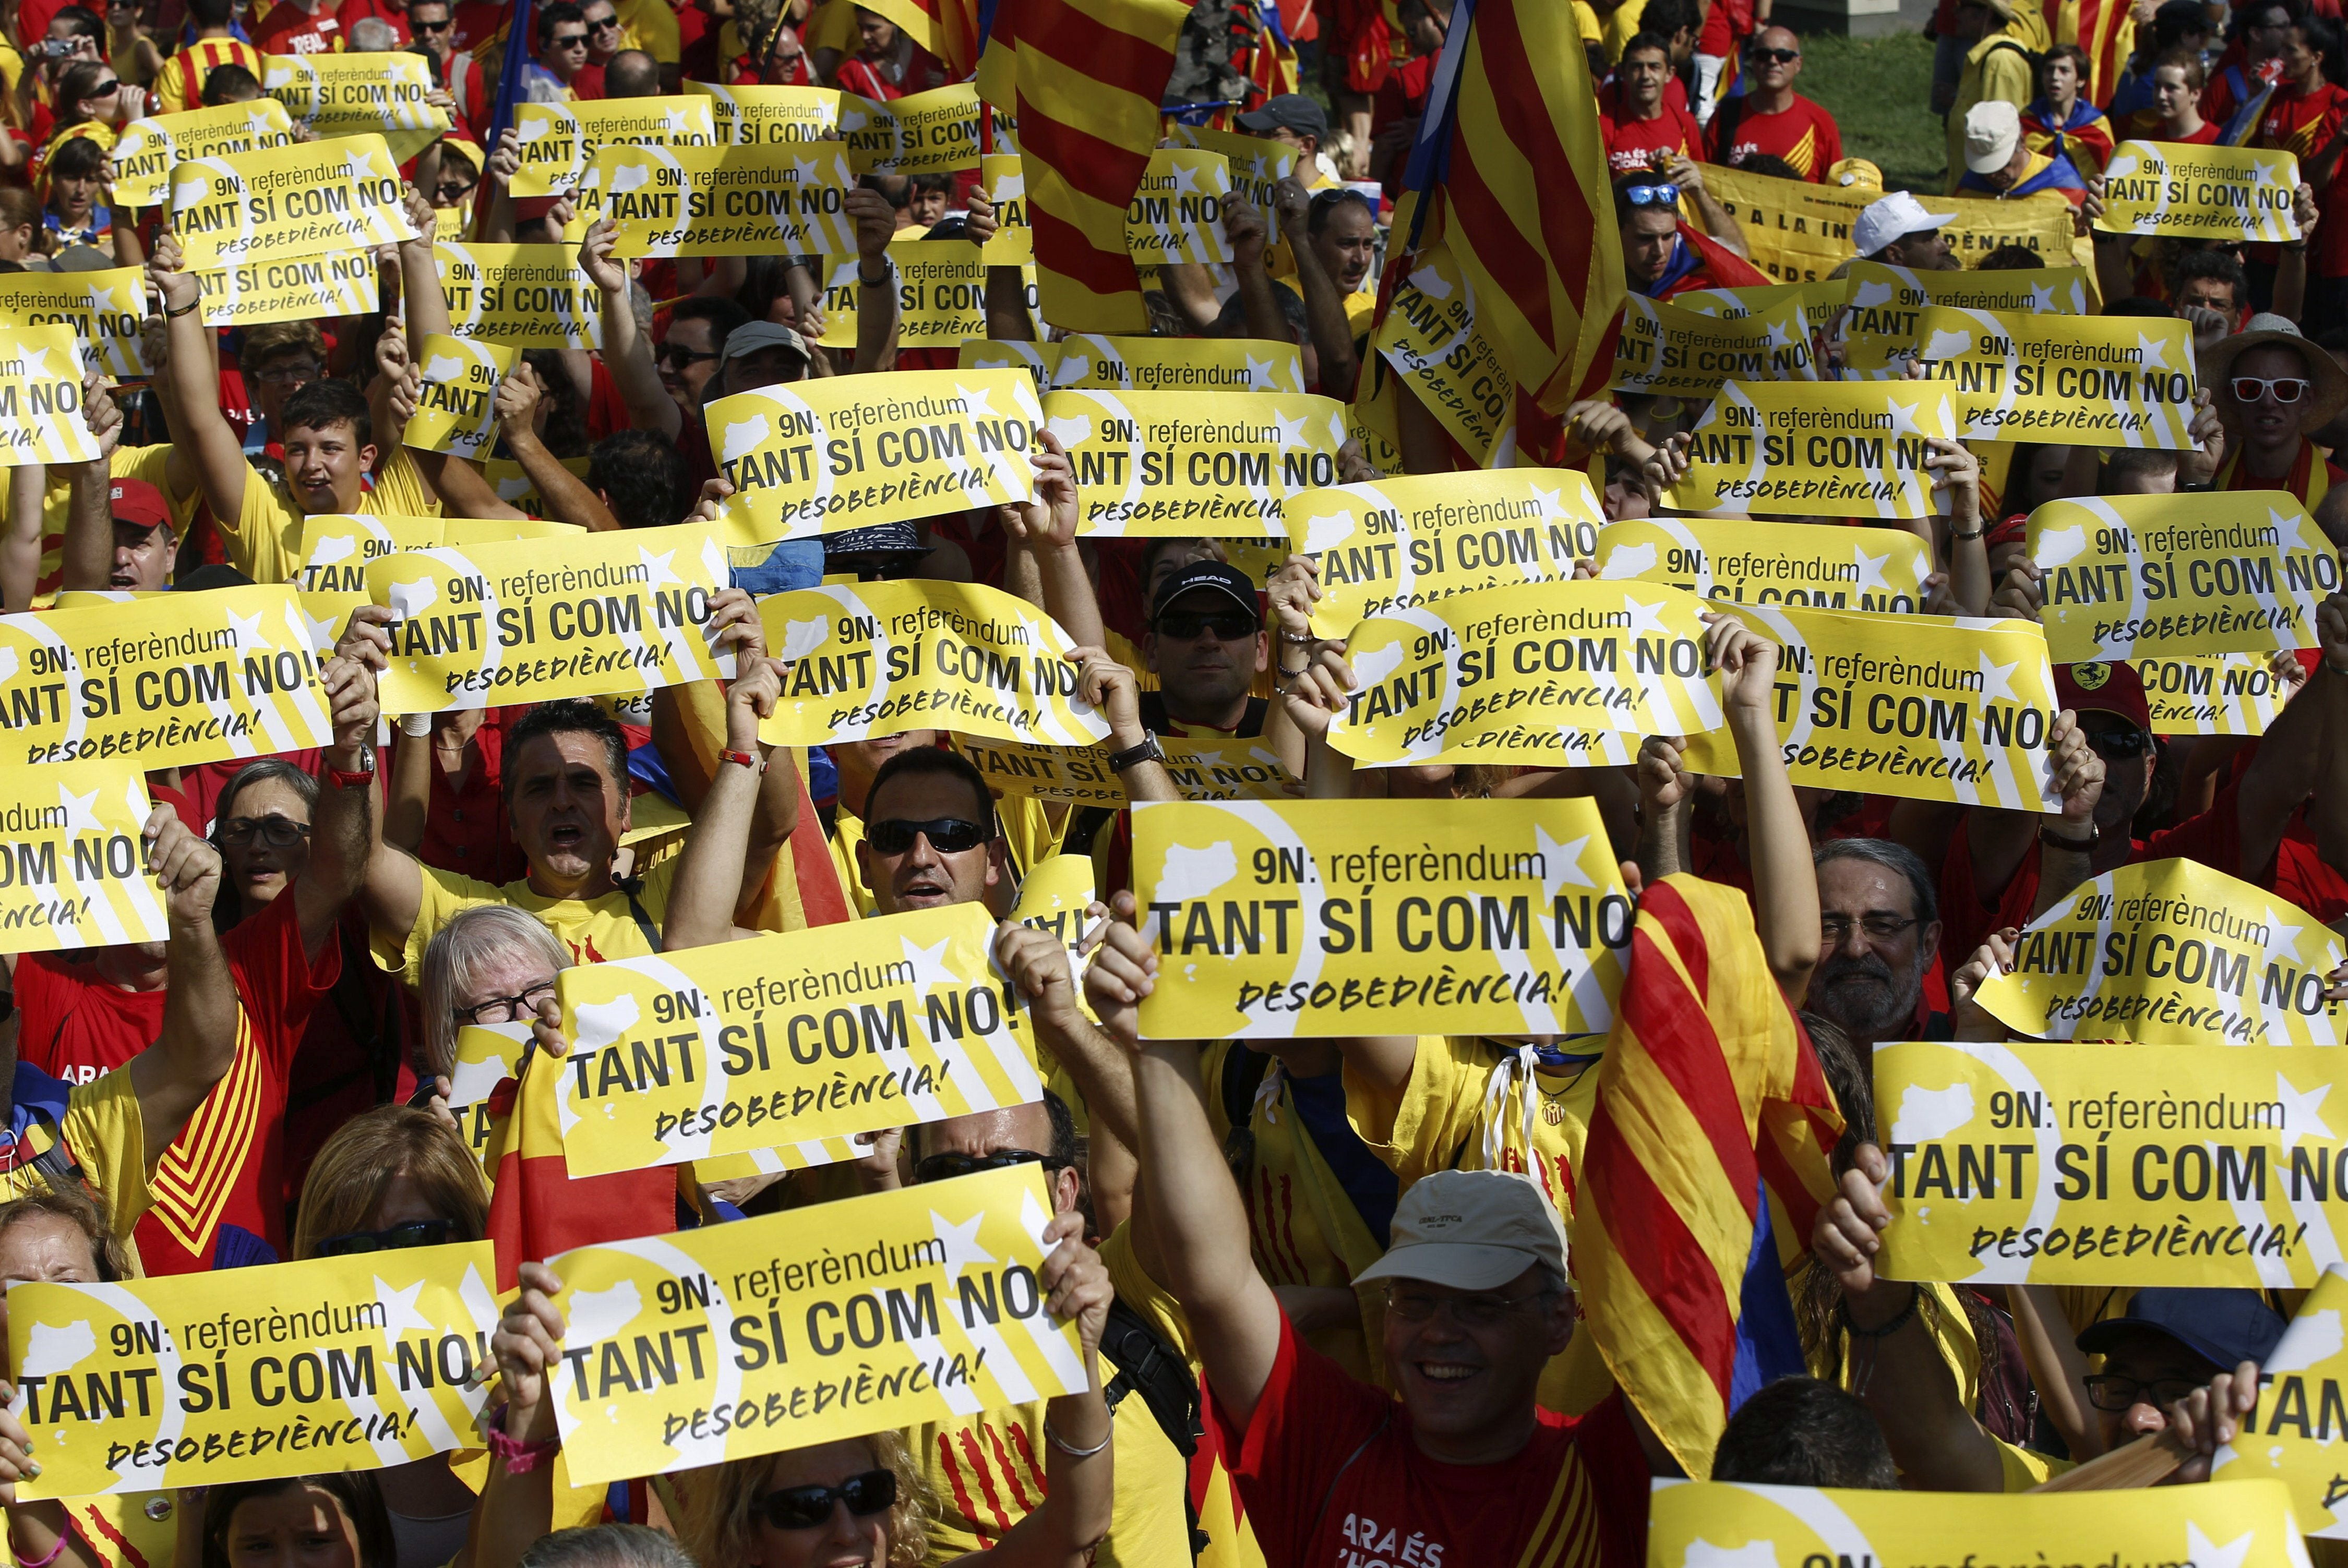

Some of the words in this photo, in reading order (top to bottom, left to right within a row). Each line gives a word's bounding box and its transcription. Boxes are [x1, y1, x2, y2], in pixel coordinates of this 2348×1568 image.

[322, 68, 392, 81] referèndum
[344, 85, 392, 103] COM
[716, 102, 739, 116] 9N:
[744, 103, 822, 118] referèndum
[148, 133, 172, 148] 9N:
[176, 121, 255, 143] referèndum
[555, 120, 580, 134] 9N:
[586, 116, 670, 133] referèndum
[872, 115, 899, 129] 9N:
[901, 126, 924, 149] SÍ
[111, 152, 166, 179] TANT
[215, 176, 245, 196] 9N:
[251, 163, 353, 190] referèndum
[657, 168, 687, 186] 9N:
[695, 166, 798, 185] referèndum
[2143, 160, 2167, 174] 9N:
[2174, 163, 2257, 182] referèndum
[172, 201, 238, 234] TANT
[244, 198, 267, 224] SÍ
[285, 185, 349, 218] COM
[607, 192, 678, 219] TANT
[688, 186, 716, 218] SÍ
[726, 190, 789, 216] COM
[2104, 178, 2159, 201] TANT
[2167, 178, 2189, 203] SÍ
[2198, 184, 2249, 207] COM
[648, 222, 810, 245] DESOBEDIÈNCIA!
[1751, 209, 1764, 226] A
[1779, 214, 1807, 234] LA
[2133, 208, 2264, 228] DESOBEDIÈNCIA!
[216, 216, 371, 256] DESOBEDIÈNCIA!
[236, 263, 258, 292] SÍ
[267, 262, 324, 289] COM
[331, 255, 373, 280] NO!
[452, 264, 480, 281] 9N:
[486, 263, 581, 282] referèndum
[207, 288, 342, 317] DESOBEDIÈNCIA!
[480, 282, 505, 311] SÍ
[513, 287, 573, 313] COM
[900, 280, 925, 310] SÍ
[1447, 300, 1474, 335] 9N:
[1635, 317, 1663, 339] 9N:
[1670, 330, 1771, 349] referèndum
[1848, 305, 1919, 336] TANT
[1445, 344, 1484, 379] SÍ
[1661, 345, 1690, 368] SÍ
[1698, 352, 1762, 371] COM
[1773, 337, 1812, 370] NO!
[1980, 336, 2015, 356] 9N:
[2023, 339, 2142, 365] referèndum
[470, 365, 500, 387] 9N:
[1097, 360, 1128, 381] 9N:
[1136, 363, 1251, 384] referèndum
[2014, 359, 2047, 395] SÍ
[2057, 367, 2132, 401] COM
[420, 380, 488, 418] TANT
[779, 411, 821, 438] 9N:
[830, 396, 968, 436] referèndum
[1101, 420, 1139, 442] 9N:
[1149, 419, 1280, 443] referèndum
[1725, 407, 1760, 427] 9N:
[1769, 407, 1893, 429] referèndum
[1964, 406, 2152, 431] DESOBEDIÈNCIA!
[721, 445, 812, 495] TANT
[827, 428, 865, 476] SÍ
[877, 423, 965, 467] COM
[1141, 444, 1175, 486] SÍ
[1189, 452, 1269, 486] COM
[1764, 429, 1795, 465] SÍ
[1807, 436, 1883, 468] COM
[1715, 475, 1906, 501] DESOBEDIÈNCIA!
[1409, 534, 1444, 575] SÍ
[1457, 527, 1538, 570] COM
[2096, 528, 2136, 554] 9N:
[2145, 523, 2279, 552] referèndum
[448, 575, 492, 604] 9N:
[501, 562, 649, 598] referèndum
[1181, 574, 1232, 585] HEAD
[1668, 549, 1708, 574] 9N:
[1718, 552, 1859, 585] referèndum
[2141, 552, 2177, 600] SÍ
[2189, 557, 2275, 597] COM
[381, 611, 481, 656] TANT
[497, 597, 535, 646] SÍ
[550, 594, 642, 640] COM
[887, 633, 923, 682] SÍ
[937, 638, 1020, 695] COM
[81, 667, 120, 718] SÍ
[136, 661, 230, 710] COM
[244, 650, 315, 696] NO!
[1346, 661, 1443, 726] TANT
[1457, 638, 1496, 687] SÍ
[1514, 638, 1616, 673] COM
[828, 689, 1041, 731] DESOBEDIÈNCIA!
[1401, 679, 1648, 749] DESOBEDIÈNCIA!
[1811, 681, 1855, 729] SÍ
[1868, 694, 1973, 742] COM
[1212, 765, 1283, 784] NO!
[1148, 900, 1298, 955] TANT
[1320, 885, 1374, 954] SÍ
[1397, 896, 1529, 952] COM
[2077, 895, 2111, 920] 9N:
[2116, 892, 2269, 949] referèndum
[2103, 923, 2142, 976] SÍ
[2146, 936, 2249, 999] COM
[1236, 965, 1572, 1012] DESOBEDIÈNCIA!
[567, 1033, 698, 1099] TANT
[718, 1010, 770, 1076] SÍ
[788, 1000, 909, 1064] COM
[926, 981, 1020, 1042] NO!
[654, 1057, 953, 1143] DESOBEDIÈNCIA!
[1886, 1144, 2033, 1199] TANT
[2055, 1131, 2110, 1200] SÍ
[2133, 1145, 2266, 1201] COM
[1969, 1215, 2307, 1260] DESOBEDIÈNCIA!
[562, 1324, 708, 1401] TANT
[730, 1297, 787, 1370] SÍ
[807, 1283, 940, 1356] COM
[17, 1367, 157, 1424] TANT
[178, 1349, 230, 1413] SÍ
[250, 1346, 377, 1406] COM
[1343, 1512, 1396, 1558] ARA
